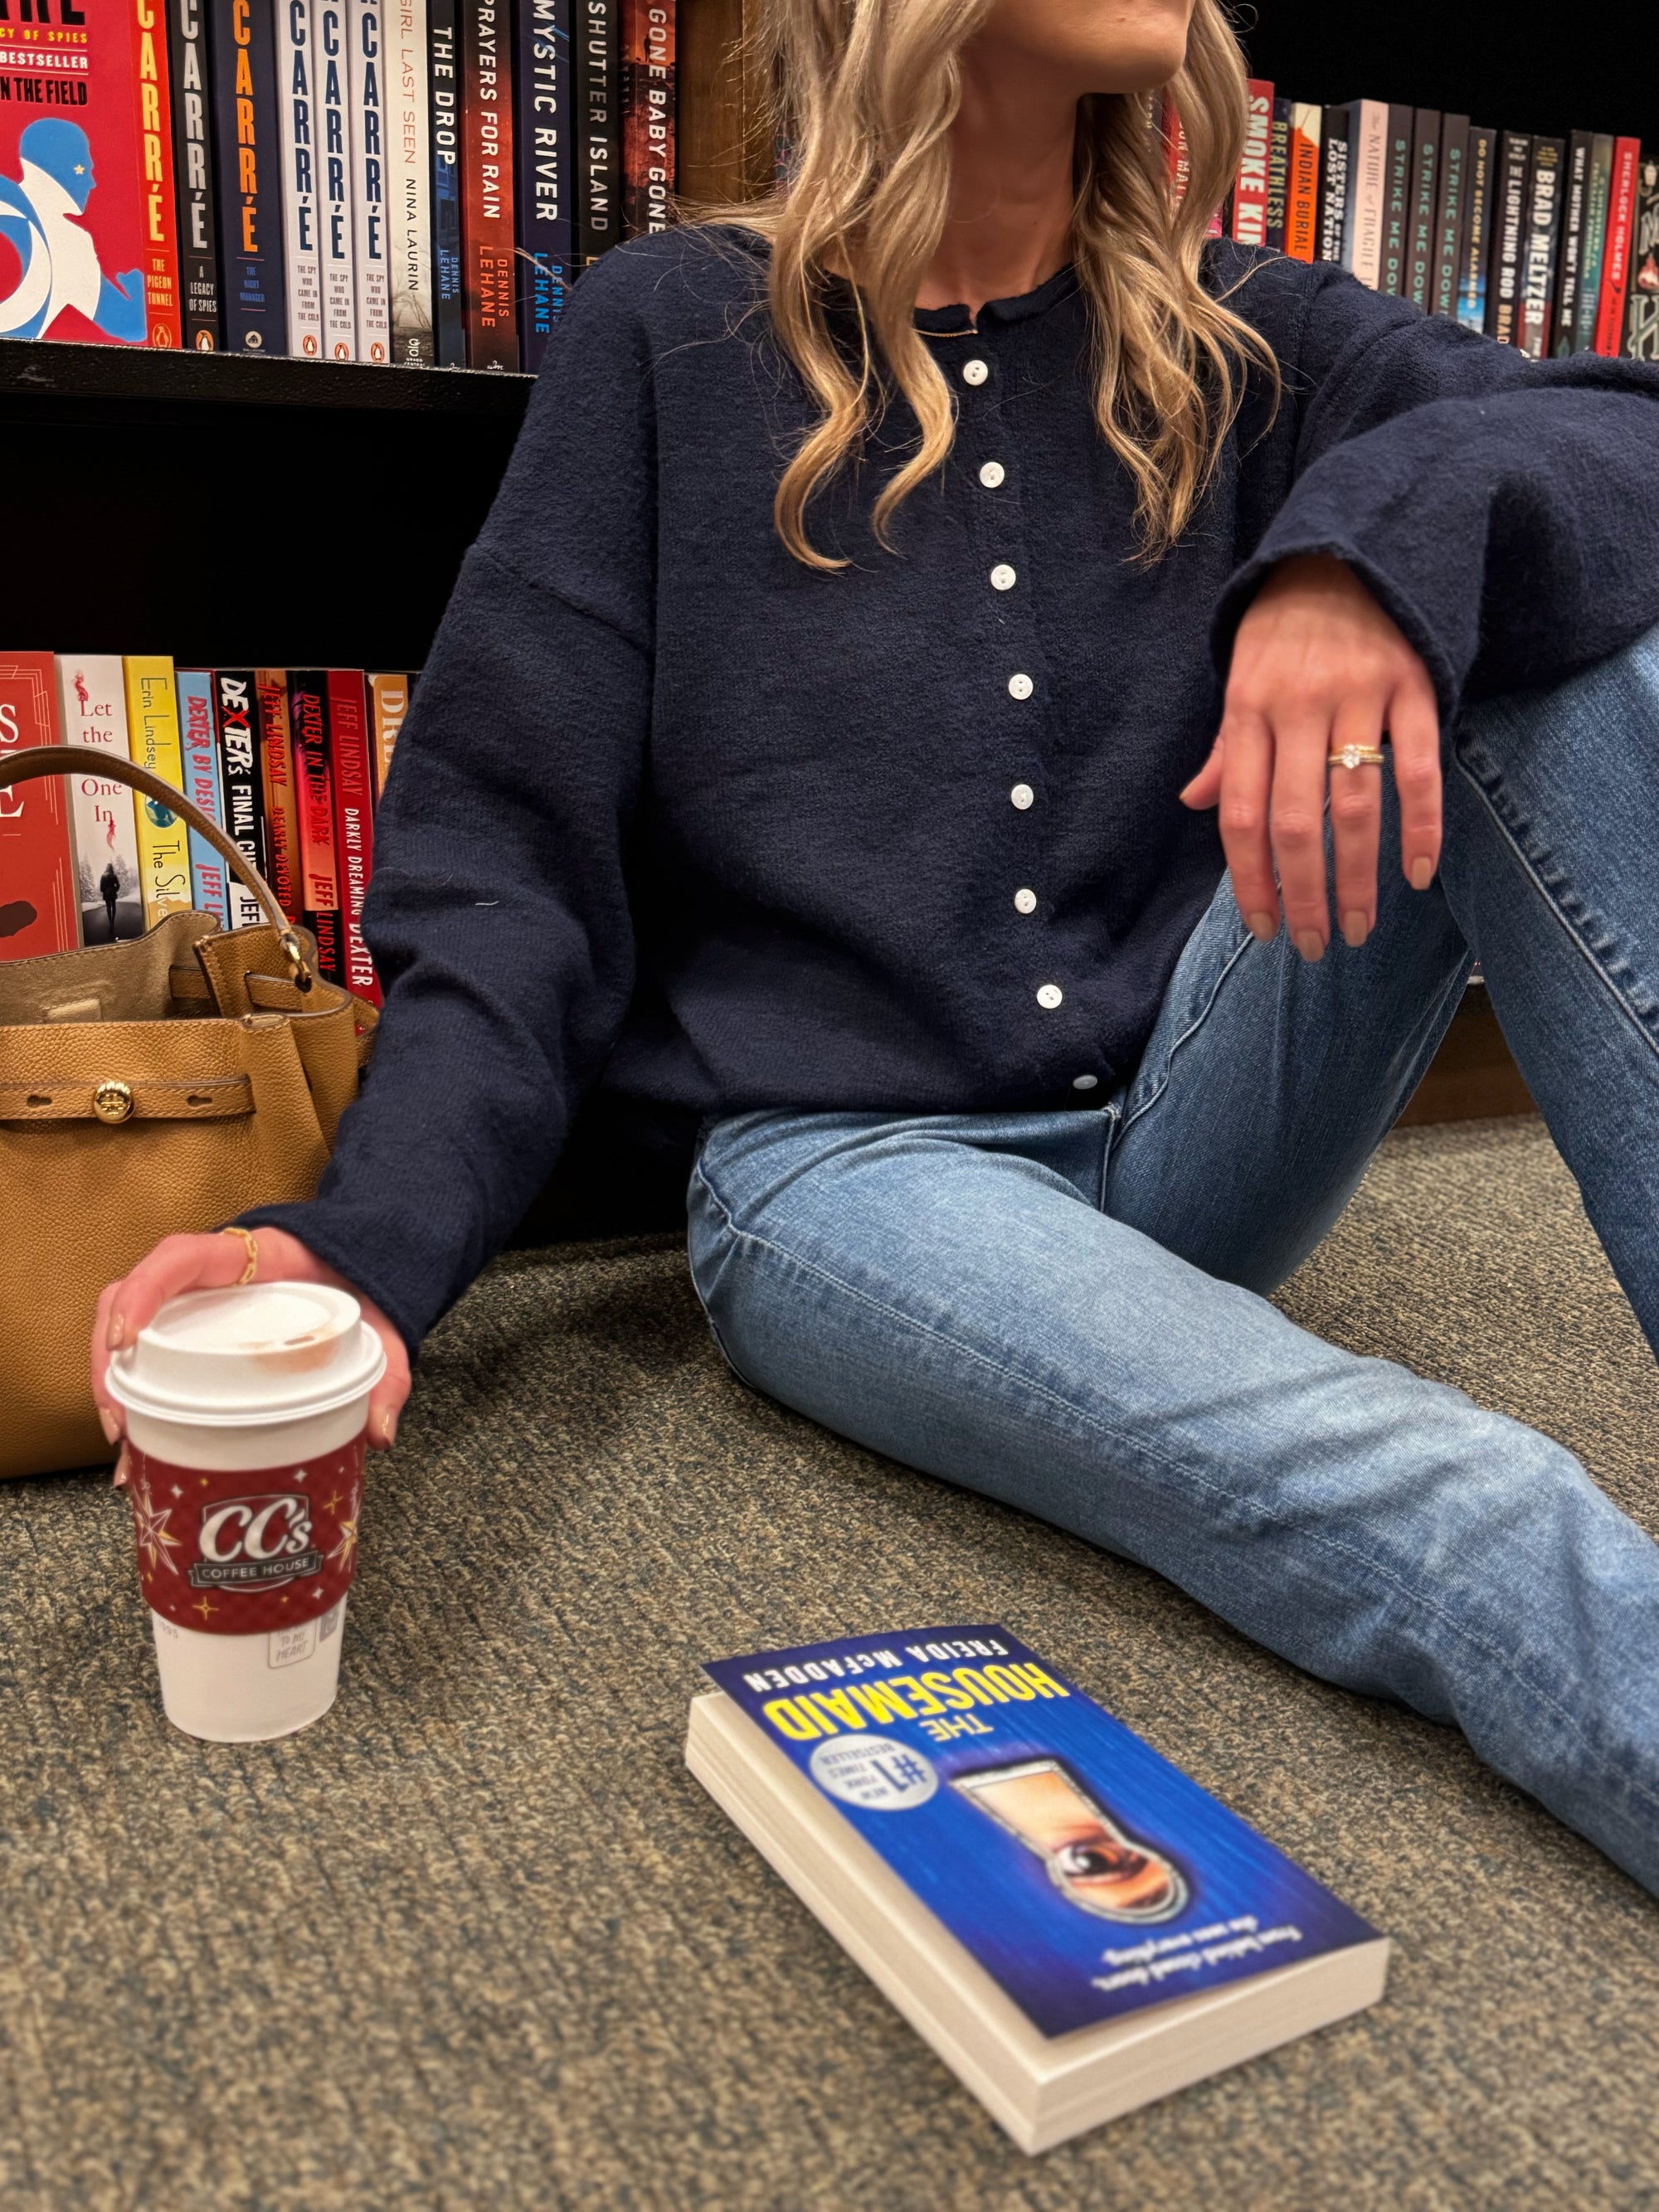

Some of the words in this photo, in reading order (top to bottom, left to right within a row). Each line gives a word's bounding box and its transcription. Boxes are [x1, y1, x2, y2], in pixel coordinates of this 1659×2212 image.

[23, 30, 39, 41] OF
[48, 32, 87, 44] SPIES
[433, 27, 454, 79] THE
[533, 0, 557, 114] MYSTIC
[649, 8, 667, 79] GONE
[0, 51, 88, 70] BESTSELLER
[401, 48, 415, 103] LAST
[587, 1, 606, 123] SHUTTER
[13, 77, 43, 103] THE
[46, 80, 88, 106] FIELD
[180, 0, 207, 248] CARRÉ
[232, 0, 258, 252] CARRÉ
[290, 0, 313, 250] CARRÉ
[323, 10, 345, 259] CARRÉ
[362, 12, 382, 260] CARRÉ
[403, 110, 416, 163] SEEN
[435, 91, 456, 165] DROP
[480, 111, 499, 157] FOR
[649, 90, 666, 158] BABY
[1238, 95, 1270, 193] SMOKE
[1298, 143, 1314, 196] INDIAN
[1327, 138, 1340, 182] LOST
[1477, 139, 1487, 158] DO
[1574, 147, 1585, 182] WHAT
[482, 164, 500, 219] RAIN
[534, 128, 558, 221] RIVER
[589, 136, 609, 231] ISLAND
[1267, 121, 1288, 229] BREATHLESS
[1333, 139, 1348, 221] SISTERS
[1391, 139, 1407, 212] STRIKE
[1418, 143, 1434, 216] STRIKE
[1446, 148, 1462, 220] STRIKE
[1476, 161, 1486, 187] NOT
[1618, 152, 1632, 222] SHERLOCK
[406, 178, 417, 221] NINA
[649, 167, 667, 234] GONE
[1471, 189, 1483, 244] BECOME
[1533, 169, 1555, 226] BRAD
[1569, 184, 1583, 232] MOTHER
[1294, 200, 1311, 252] BURIAL
[1321, 191, 1335, 262] NATION
[1389, 221, 1402, 250] ME
[1416, 224, 1428, 253] ME
[1443, 229, 1455, 257] ME
[1502, 179, 1521, 264] LIGHTNING
[152, 258, 165, 272] THE
[199, 265, 204, 279] A
[298, 265, 306, 274] THE
[308, 266, 316, 275] SPY
[407, 229, 419, 290] LAURIN
[440, 250, 451, 300] LEHANE
[450, 257, 460, 294] DENNIS
[1612, 226, 1626, 280] HOLMES
[147, 275, 172, 289] PIGEON
[148, 292, 173, 307] TUNNEL
[190, 282, 214, 296] LEGACY
[313, 289, 318, 298] IN
[329, 274, 338, 282] THE
[339, 275, 348, 283] SPY
[366, 274, 375, 282] THE
[376, 274, 385, 283] SPY
[479, 246, 496, 328] LEHANE
[497, 259, 510, 318] DENNIS
[533, 252, 550, 333] LEHANE
[1386, 258, 1399, 297] DO
[1413, 261, 1426, 304] DOW
[1439, 265, 1452, 315] DOW
[1467, 246, 1480, 309] ALARMED
[1499, 266, 1515, 299] ROD
[1525, 233, 1550, 326] MELTZER
[1563, 276, 1574, 305] TELL
[189, 299, 198, 312] OF
[198, 299, 217, 313] SPIES
[298, 312, 306, 320] THE
[329, 297, 343, 305] CAME
[333, 309, 347, 317] FROM
[366, 297, 379, 305] CAME
[370, 309, 383, 317] FROM
[1561, 309, 1573, 328] ME
[329, 320, 338, 328] THE
[1496, 304, 1513, 344] BRAD
[80, 701, 113, 717] Let
[140, 678, 168, 708] Erin
[258, 683, 283, 719] JEFF
[330, 697, 359, 731] JEFF
[83, 727, 113, 743] the
[184, 695, 212, 751] DEXTER
[300, 693, 323, 745] DEXTER
[144, 715, 172, 770] Lindsey
[192, 754, 212, 775] BY
[265, 723, 287, 787] LINDSAY
[305, 751, 324, 767] IN
[81, 779, 123, 796] One
[338, 735, 363, 796] LINDSAY
[95, 805, 113, 823] In
[194, 778, 216, 823] DESI
[231, 785, 255, 836] FINAL
[272, 806, 288, 854] DEARLY
[310, 806, 331, 846] DARK
[344, 808, 362, 852] DARKLY
[153, 840, 180, 868] The
[195, 863, 222, 899] JEFF
[275, 854, 293, 907] DEVOTED
[309, 873, 334, 907] JEFF
[347, 856, 365, 916] DREAMING
[316, 912, 337, 972] LINDSAY
[348, 923, 374, 987] DEXTER
[202, 1568, 257, 1578] COFFEE
[262, 1557, 310, 1576] HOUSE
[742, 1649, 902, 1693] McFADDEN
[905, 1639, 1010, 1663] FREIDA
[762, 1663, 1071, 1741] HOUSEMAID
[918, 1713, 995, 1742] THE
[870, 1753, 927, 1792] #1
